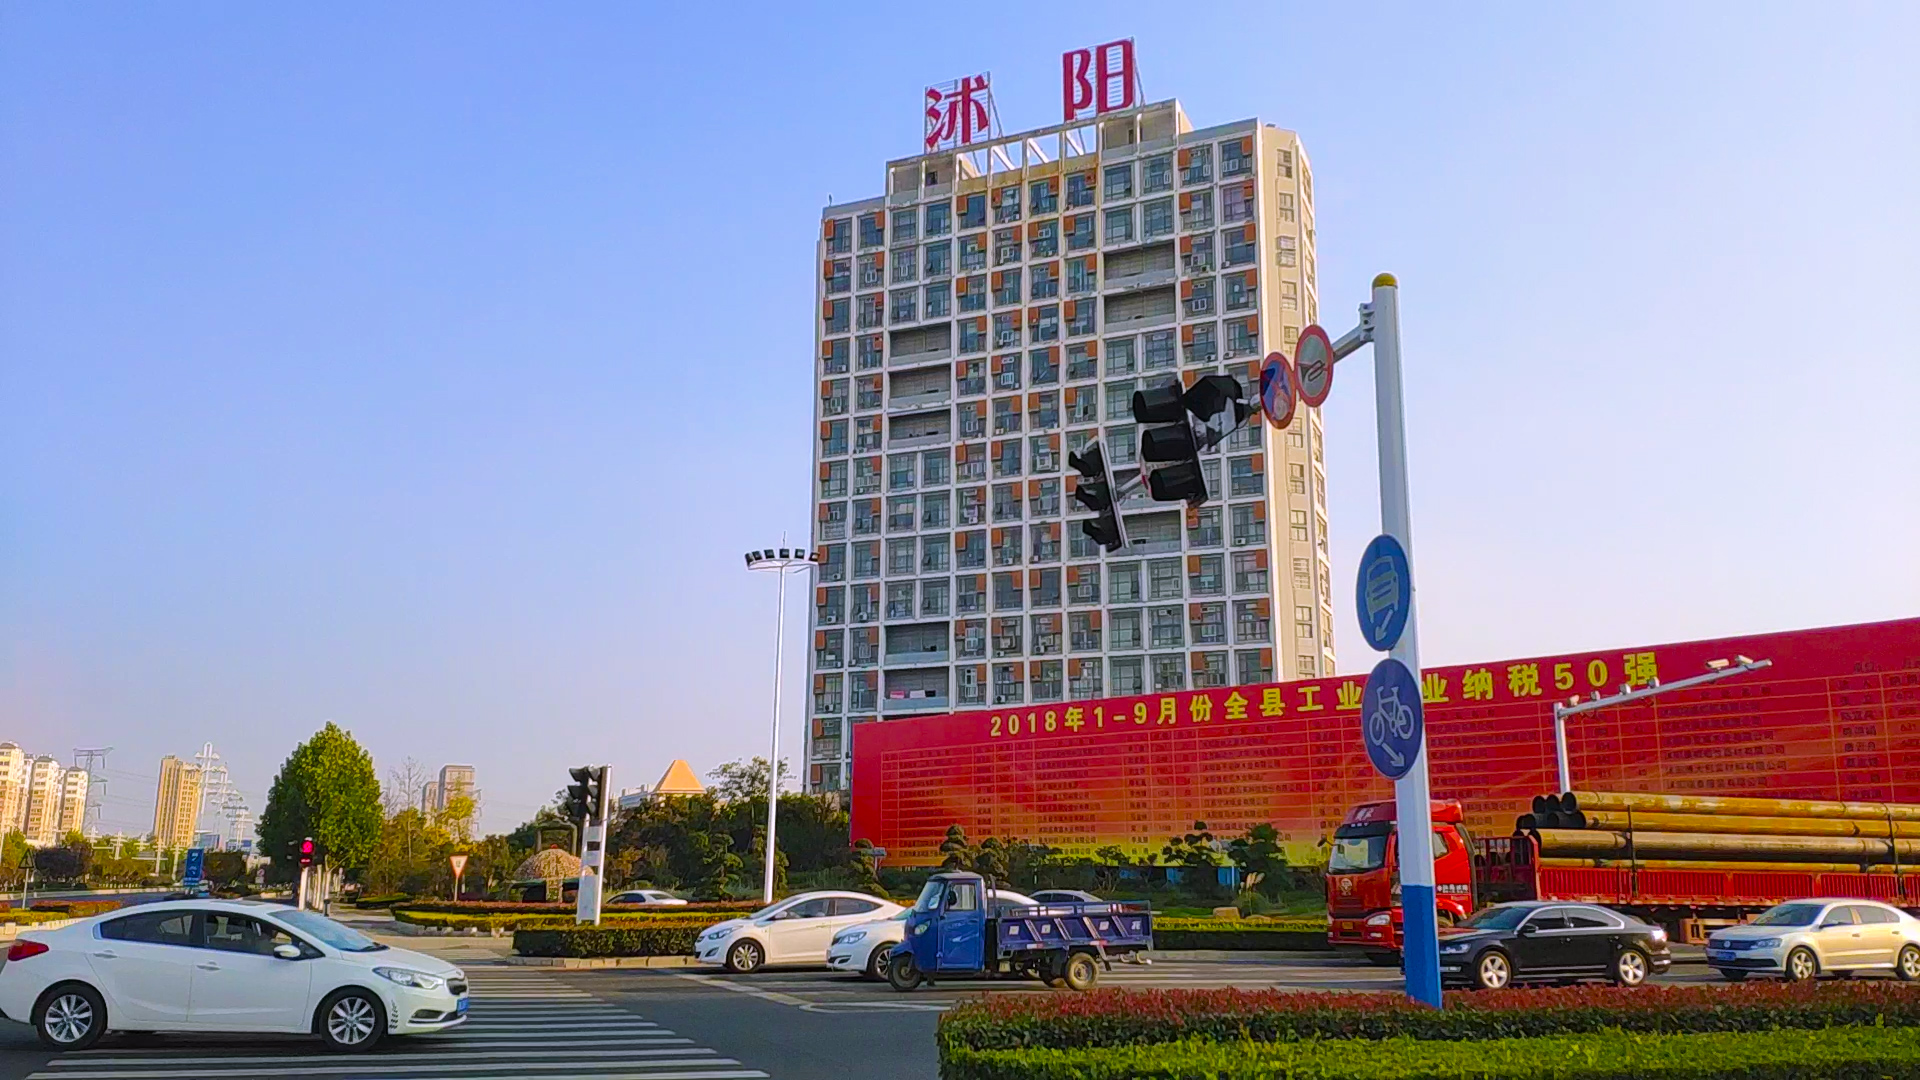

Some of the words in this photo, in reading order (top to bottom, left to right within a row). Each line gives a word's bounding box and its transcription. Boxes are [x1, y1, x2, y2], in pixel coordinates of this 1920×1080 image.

[925, 39, 1133, 148] 沭阳
[990, 652, 1660, 737] 2018年1-9月份全县工业业纳税50强
